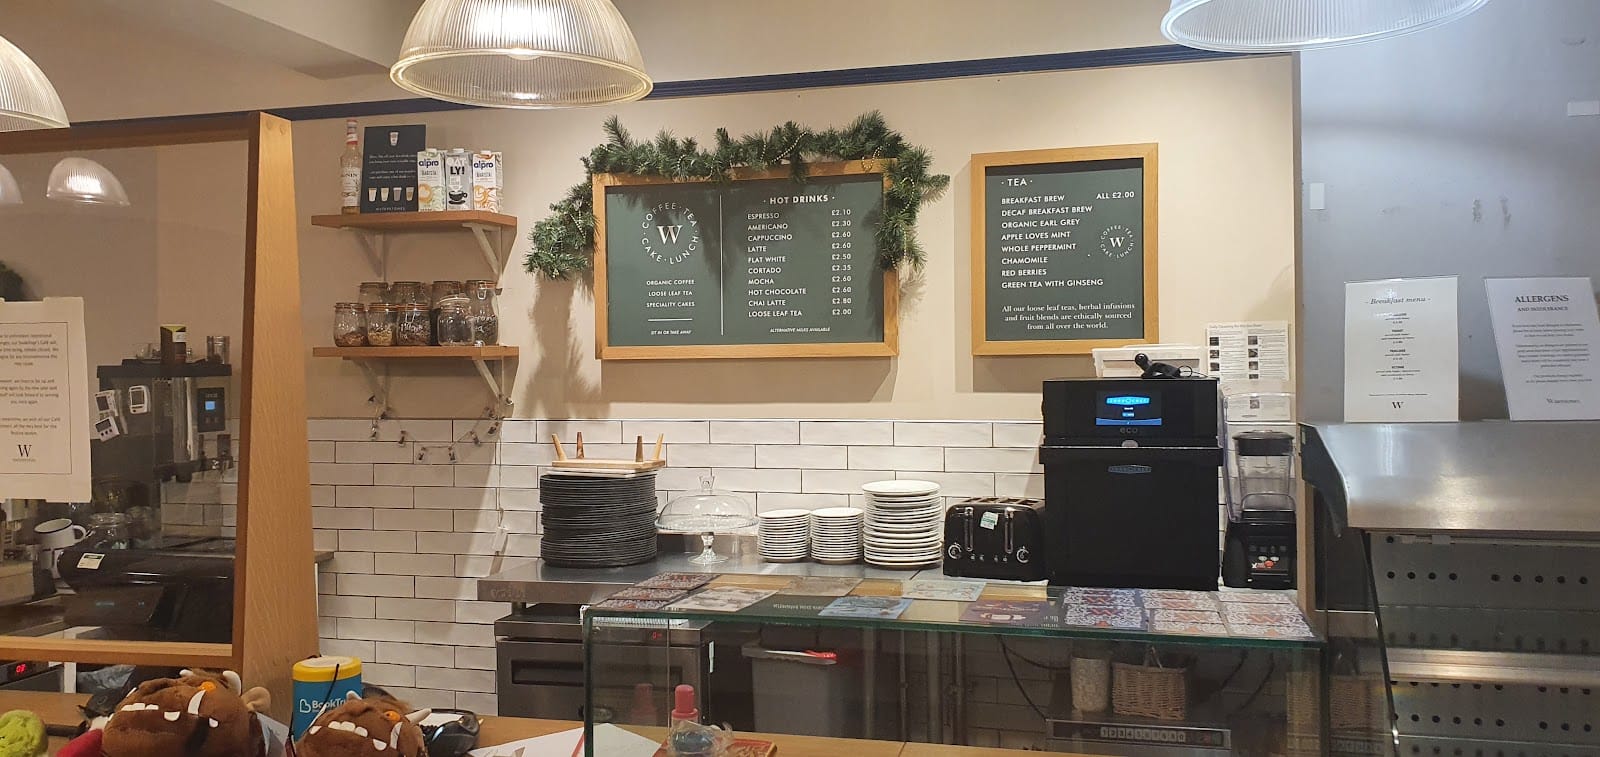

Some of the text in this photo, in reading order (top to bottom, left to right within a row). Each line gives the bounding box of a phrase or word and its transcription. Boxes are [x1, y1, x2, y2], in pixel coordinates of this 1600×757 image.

[419, 160, 439, 168] alpro
[474, 161, 493, 170] alpro
[450, 166, 464, 175] LY!
[1008, 178, 1027, 186] TEA
[792, 195, 828, 203] DRINKS
[642, 202, 697, 228] COFFEE TEA
[1028, 207, 1069, 215] BREAKFAST
[657, 225, 683, 244] W
[1110, 237, 1125, 248] W
[642, 236, 699, 264] CAKE LUNCH
[1073, 312, 1102, 320] ethically
[18, 445, 32, 457] W
